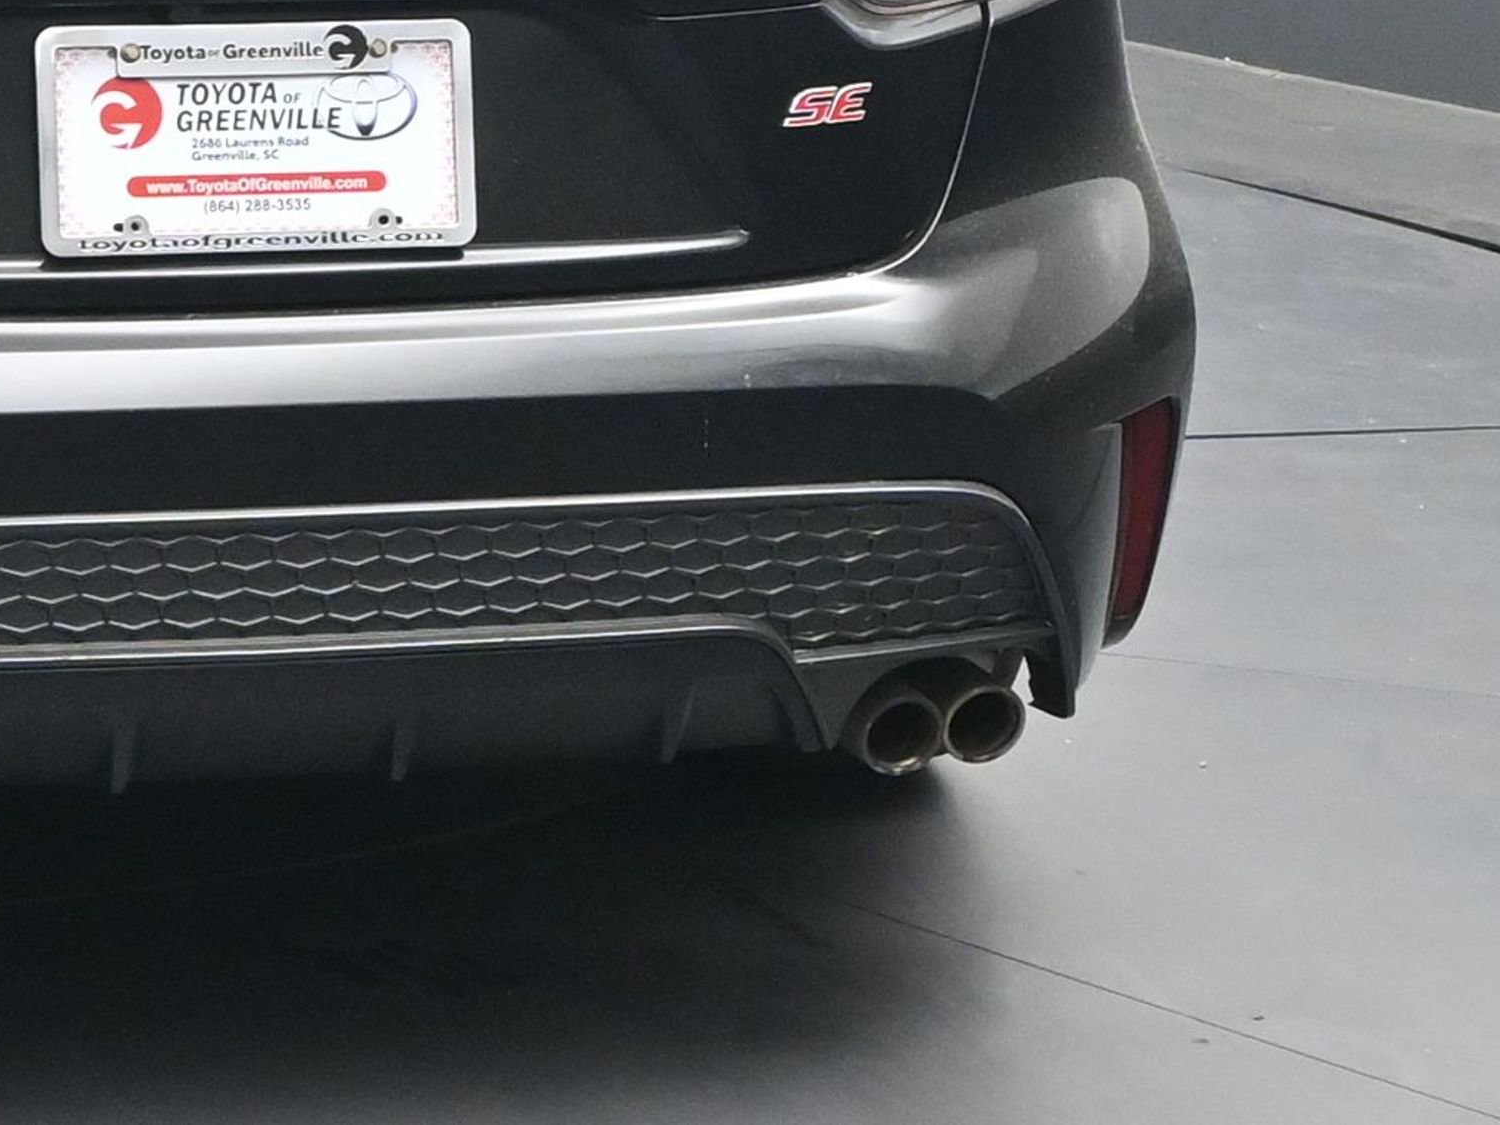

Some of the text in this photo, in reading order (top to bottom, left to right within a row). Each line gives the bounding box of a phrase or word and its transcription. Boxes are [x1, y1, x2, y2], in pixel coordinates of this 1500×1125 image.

[140, 44, 206, 63] Toyota
[222, 42, 324, 59] Greenville
[177, 82, 301, 106] TOYOTA OF
[783, 82, 873, 127] SE
[176, 107, 342, 132] GREENVILLE
[225, 137, 274, 148] Laurens
[277, 136, 309, 147] Road
[192, 149, 279, 161] Greenville, SC
[146, 176, 368, 195] www.ToyotaOfGreenville.com
[204, 198, 311, 214] (864) 288-3535
[79, 231, 443, 252] toyotaofgreenville.com
